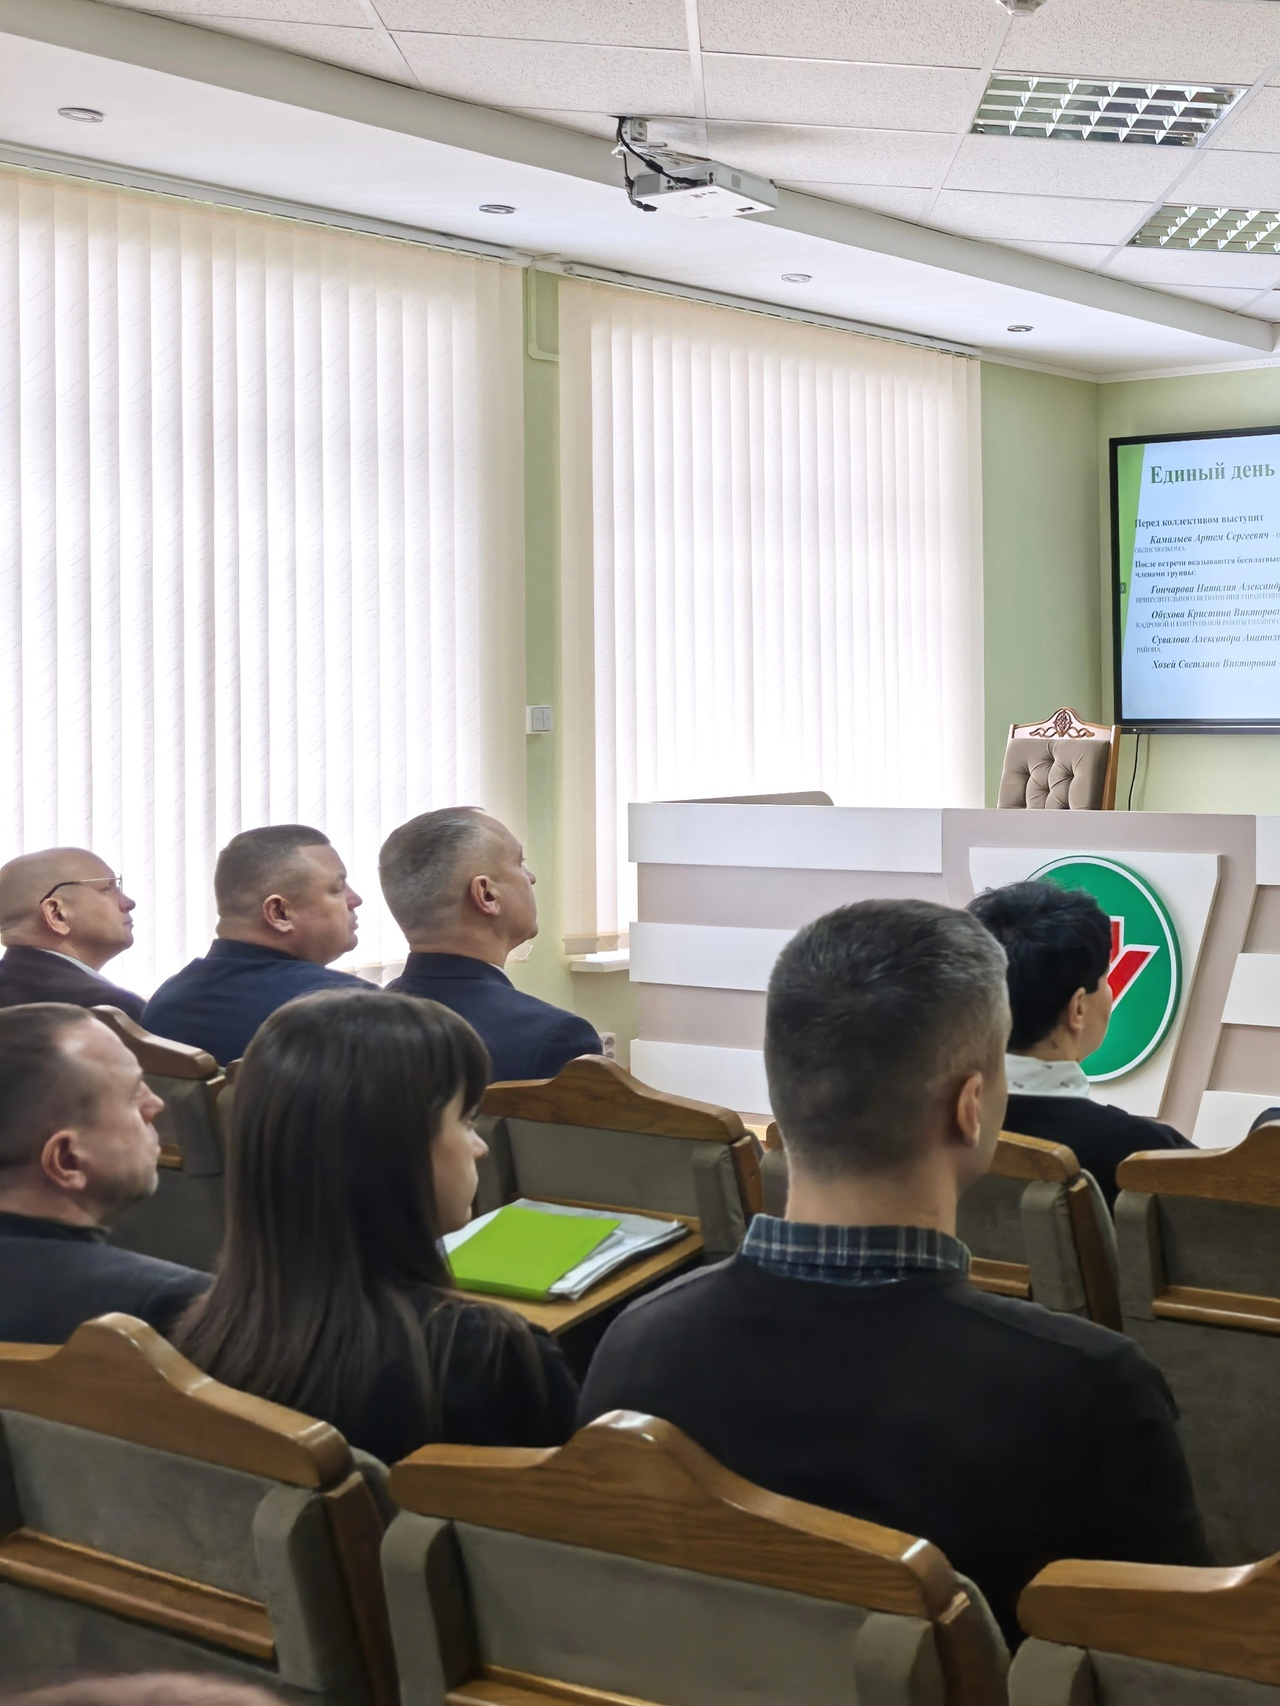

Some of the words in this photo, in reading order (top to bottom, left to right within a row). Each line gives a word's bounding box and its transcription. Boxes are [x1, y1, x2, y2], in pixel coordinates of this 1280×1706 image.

[1150, 461, 1226, 485] Единый
[1231, 463, 1275, 481] день
[1134, 517, 1160, 530] Перед
[1162, 515, 1219, 527] коллективом
[1221, 513, 1264, 525] выступит
[1195, 532, 1223, 544] Артем
[1226, 530, 1269, 543] Сергеевич
[1134, 545, 1185, 553] ОБЛИСПОЛКОМА
[1135, 559, 1156, 568] После
[1158, 559, 1186, 569] встречи
[1188, 557, 1235, 567] оказываются
[1237, 555, 1280, 565] бесплатные
[1135, 571, 1166, 579] членами
[1151, 584, 1195, 595] Гончарова
[1196, 582, 1236, 593] Наталия
[1135, 595, 1196, 603] ПРИНУДИТЕЛЬНОГО
[1196, 593, 1240, 601] ИСПОЛНЕНИЯ
[1151, 609, 1185, 621] Обухова
[1187, 608, 1232, 620] Кристина
[1135, 620, 1169, 629] КАДРОВОЙ
[1176, 618, 1221, 627] КОНТРОЛЬНОЙ
[1222, 618, 1247, 626] РАБОТЫ
[1152, 634, 1190, 647] Сувалова
[1192, 633, 1241, 645] Александра
[1178, 658, 1221, 669] Светлана
[1222, 658, 1277, 670] Викторовна
